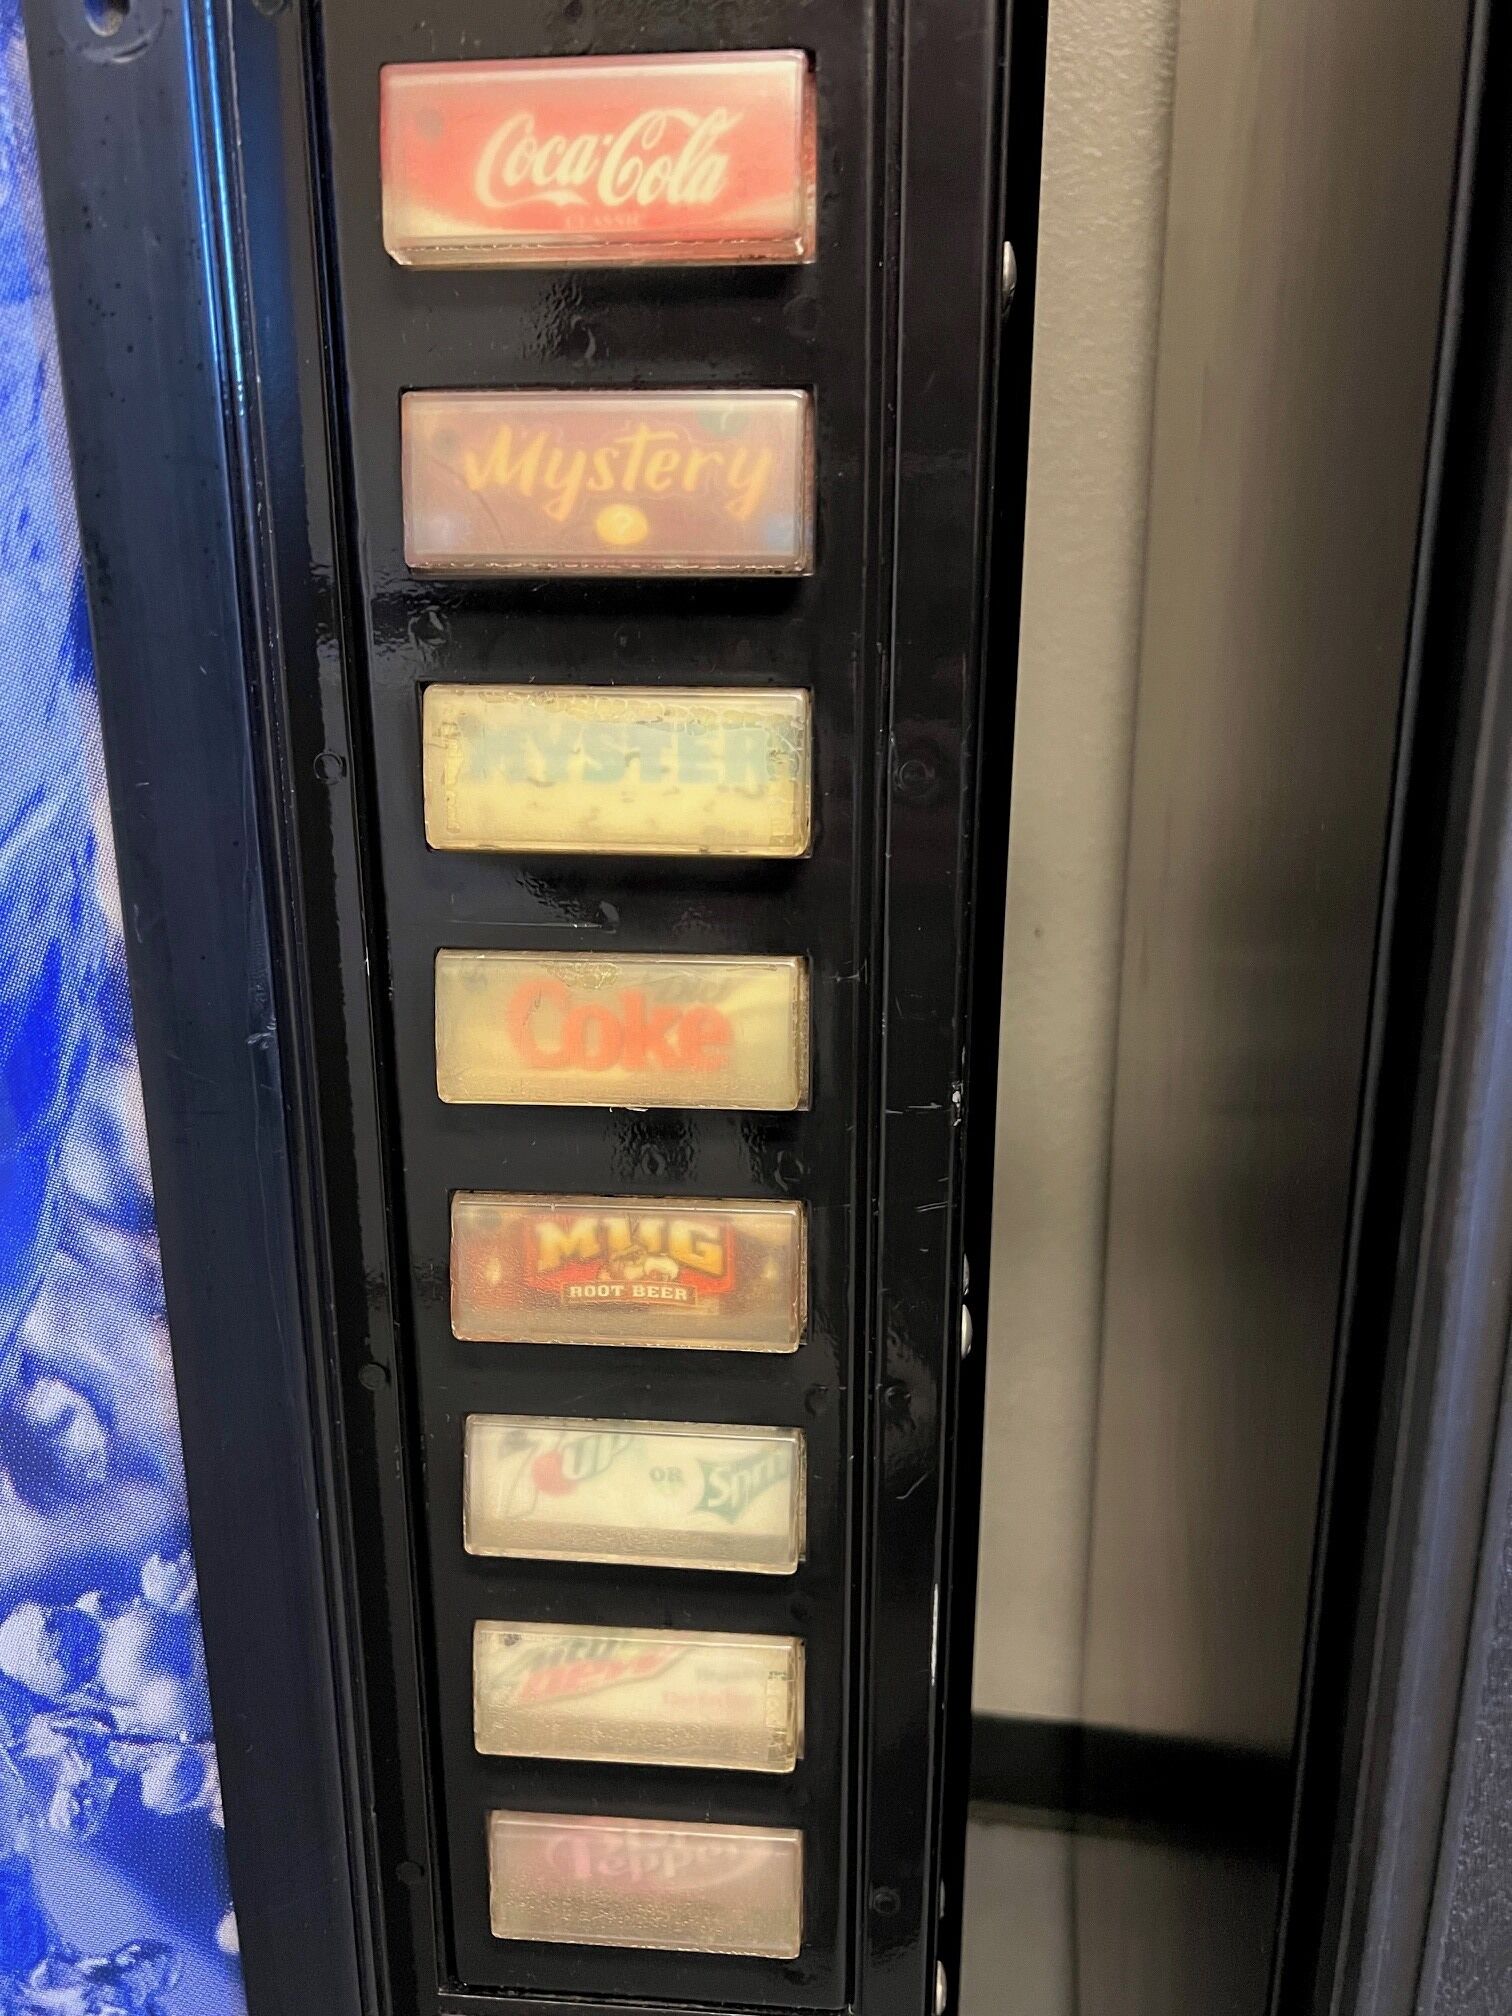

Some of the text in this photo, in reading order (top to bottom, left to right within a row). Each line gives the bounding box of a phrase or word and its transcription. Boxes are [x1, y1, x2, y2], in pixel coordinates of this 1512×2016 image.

[474, 106, 744, 207] Coca-Cola
[463, 422, 776, 522] Mystery
[505, 976, 736, 1071] Coke
[534, 1216, 725, 1278] MUG
[569, 1284, 688, 1301] ROOT BEER
